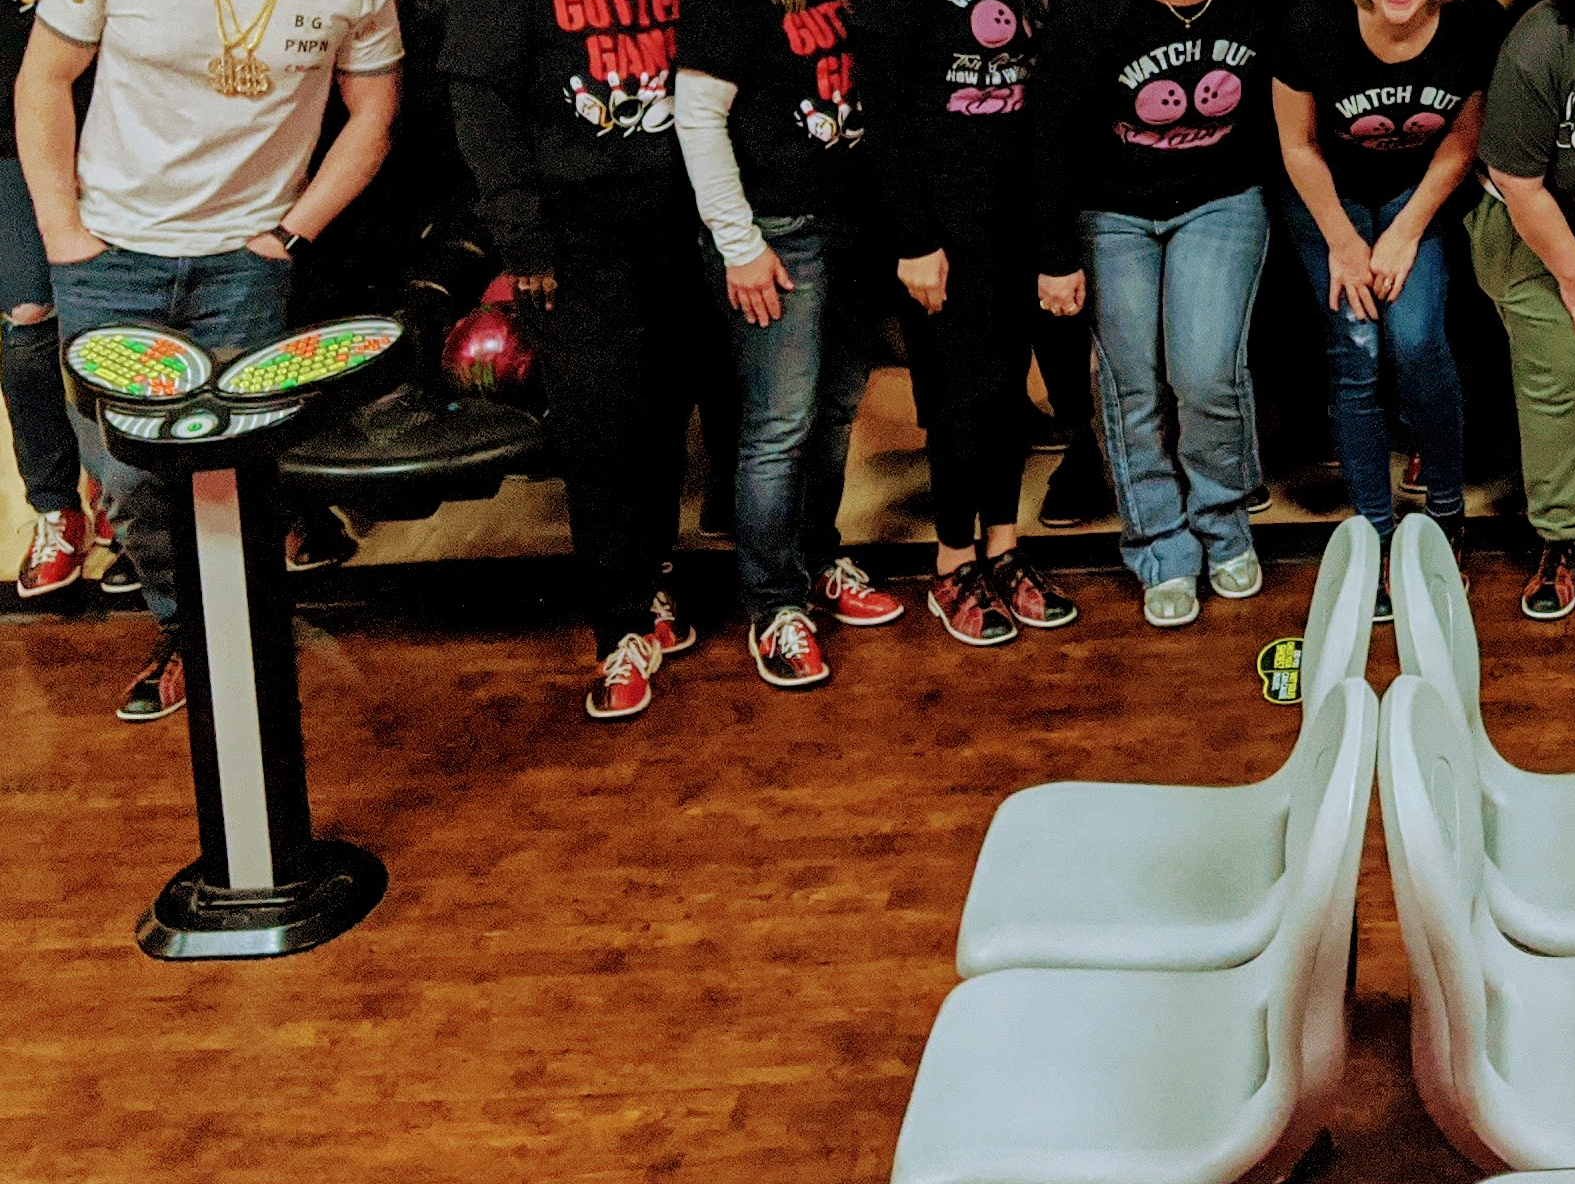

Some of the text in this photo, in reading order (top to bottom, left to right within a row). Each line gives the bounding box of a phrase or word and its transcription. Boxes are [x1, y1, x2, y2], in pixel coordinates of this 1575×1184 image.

[1118, 39, 1256, 89] WATCH OUT
[1335, 85, 1462, 119] WATCH OUT
